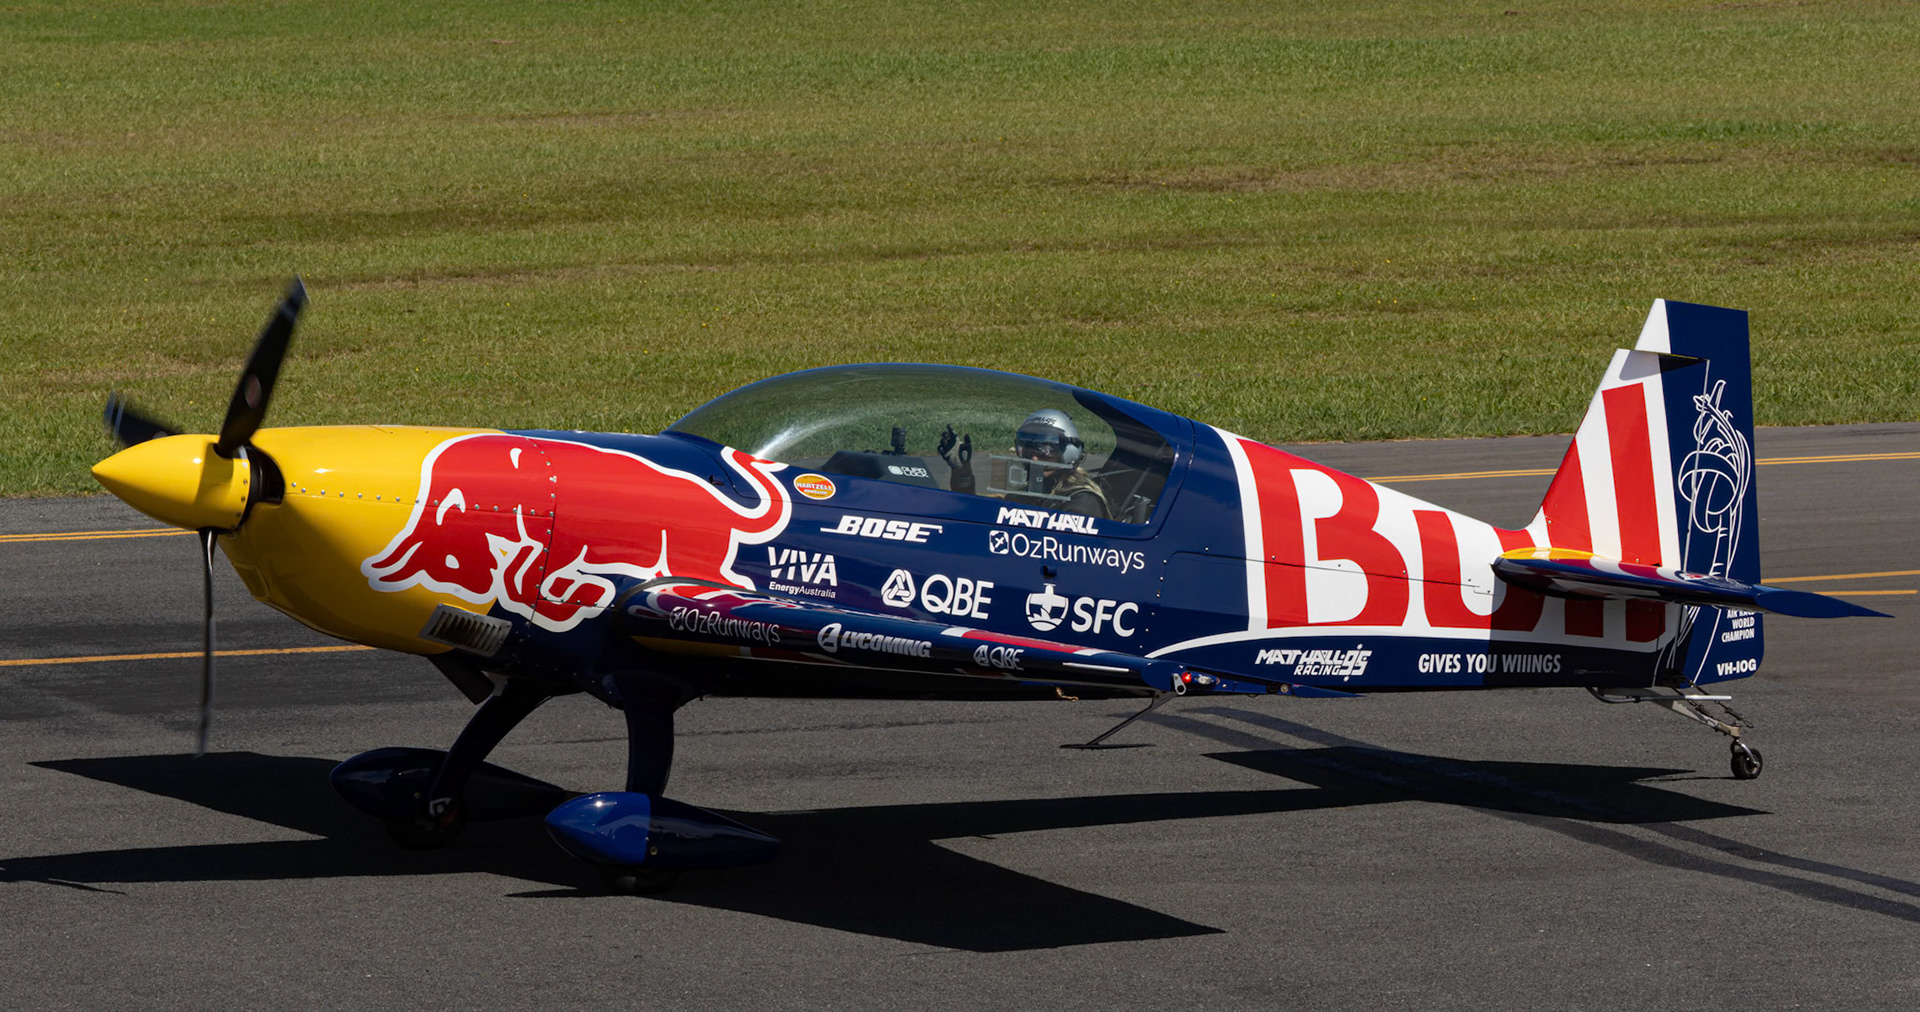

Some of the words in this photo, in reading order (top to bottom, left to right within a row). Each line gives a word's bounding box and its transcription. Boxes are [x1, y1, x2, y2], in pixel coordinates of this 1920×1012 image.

[796, 482, 833, 491] HARTZELL
[820, 515, 943, 543] BOSE
[998, 507, 1049, 527] MATT
[1048, 512, 1099, 535] HALL
[1011, 533, 1145, 573] OzRunways
[767, 546, 838, 587] VIVA
[769, 581, 836, 599] EnergyAustralia
[921, 574, 994, 620] QBE
[1071, 597, 1139, 637] SFC
[1727, 609, 1738, 619] AIR
[1731, 617, 1755, 629] WORLD
[685, 609, 780, 646] OzRunways
[1721, 628, 1755, 643] CHAMPION
[840, 630, 932, 658] LYCOMING
[989, 645, 1024, 671] QBE
[1254, 649, 1302, 665] MATT
[1299, 649, 1342, 665] HALL
[1418, 654, 1461, 673] GIVES
[1466, 654, 1497, 673] YOU
[1502, 654, 1561, 673] WIIINGS
[1716, 658, 1757, 676] VH-IOG
[1293, 664, 1341, 676] RACING
